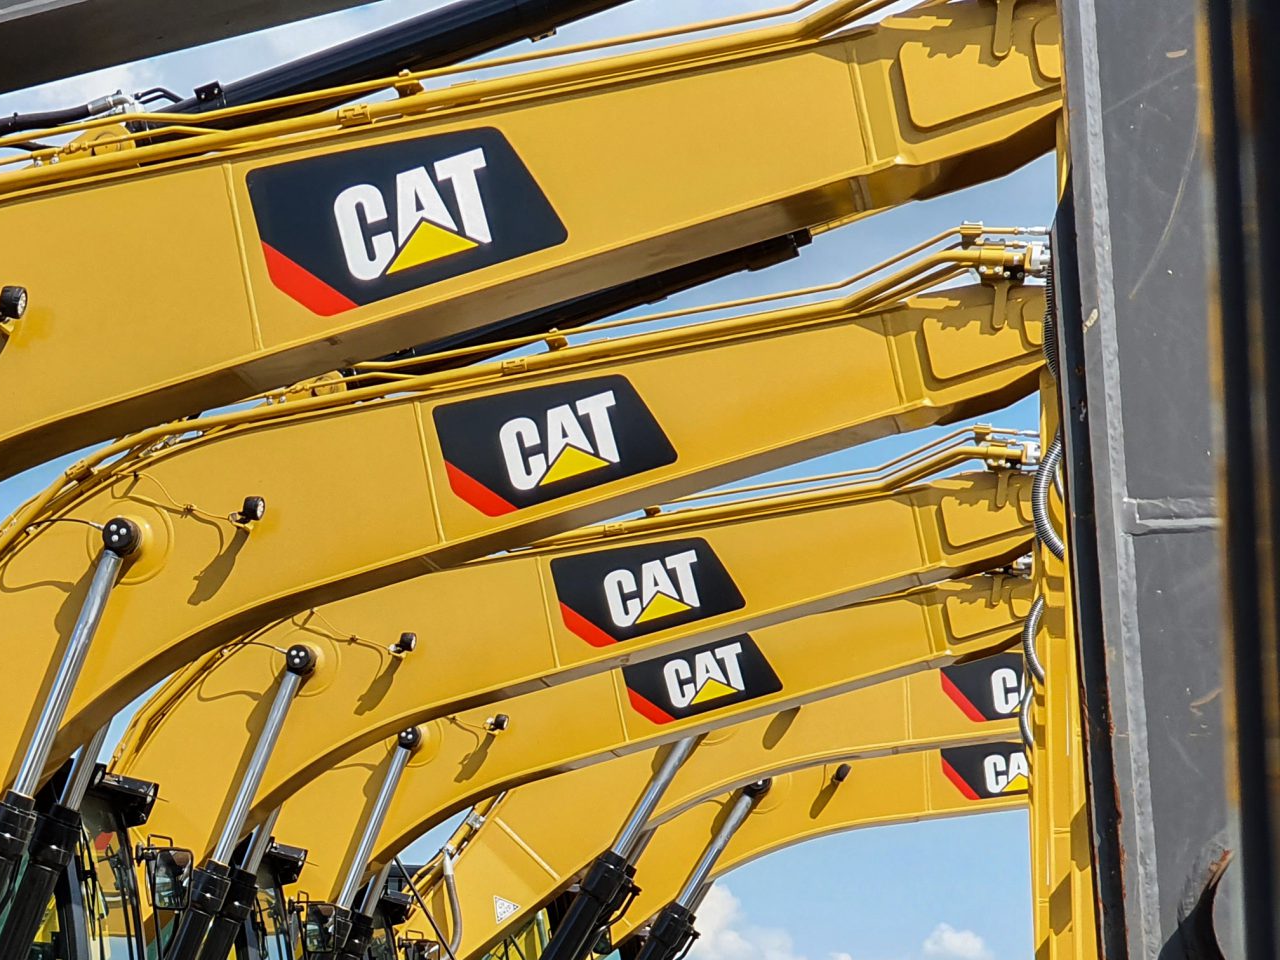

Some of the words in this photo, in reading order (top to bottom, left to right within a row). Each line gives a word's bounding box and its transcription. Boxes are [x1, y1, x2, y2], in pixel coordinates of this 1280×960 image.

[334, 148, 493, 281] CAT
[499, 390, 621, 490] CAT
[603, 549, 701, 627] CAT
[663, 642, 745, 708] CAT
[983, 751, 1029, 794] CA
